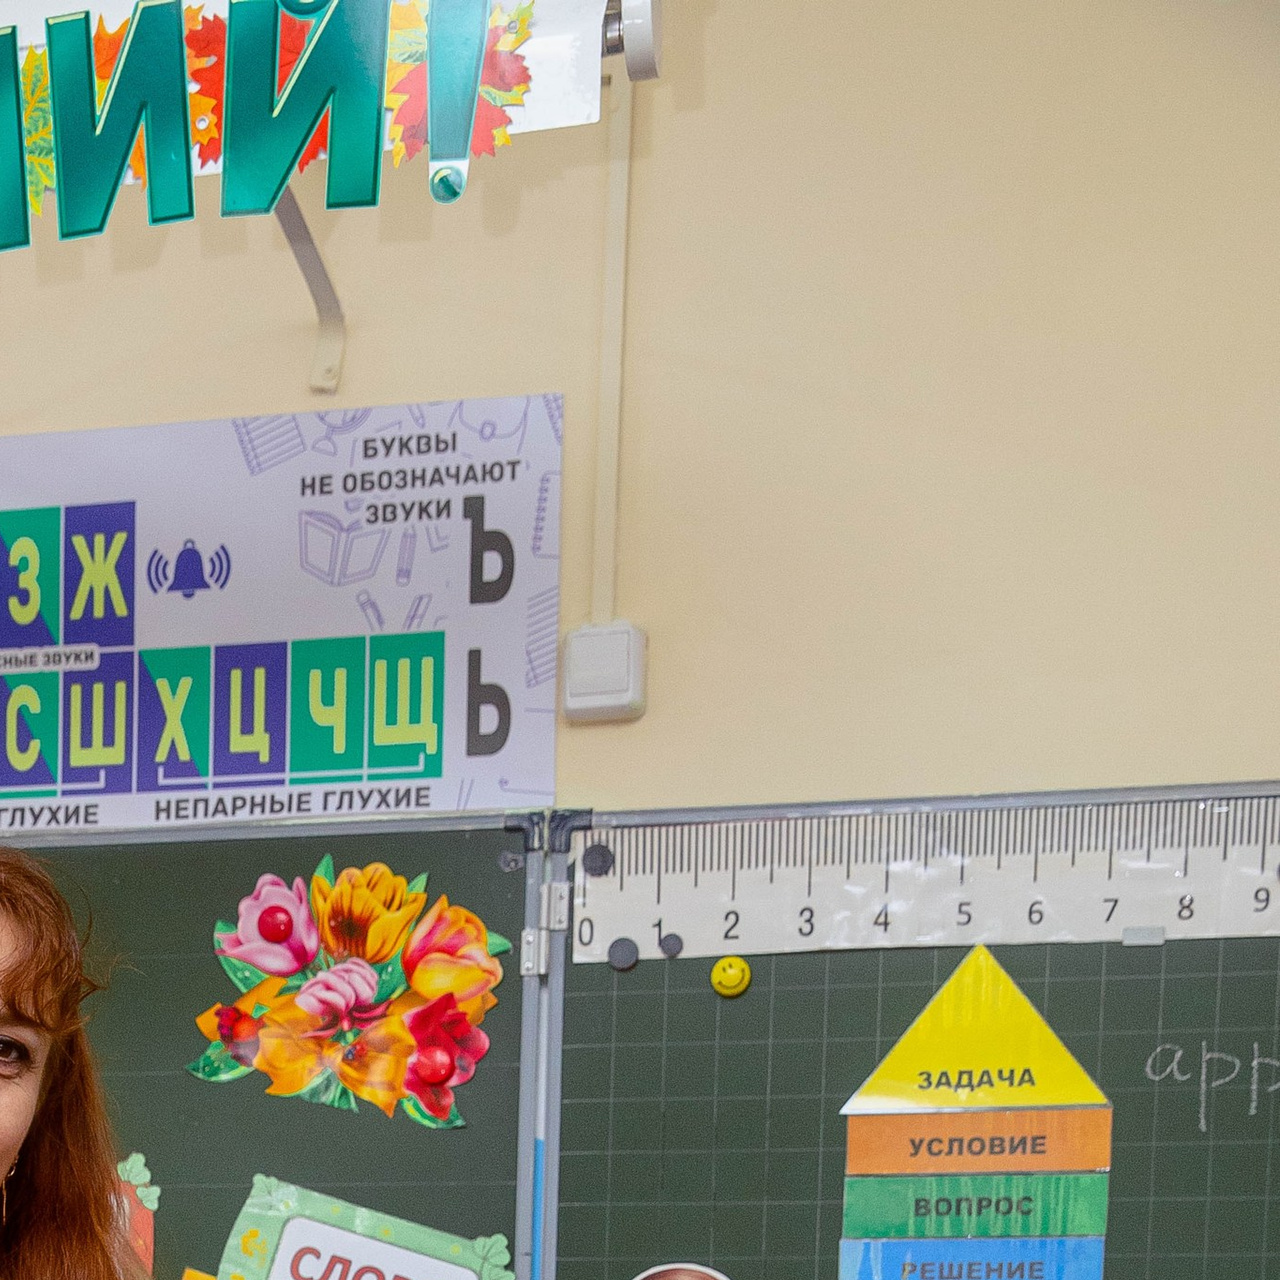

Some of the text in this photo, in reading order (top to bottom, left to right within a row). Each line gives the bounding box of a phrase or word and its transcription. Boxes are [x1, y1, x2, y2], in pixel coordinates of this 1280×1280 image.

[363, 432, 457, 460] БУКВЫ
[300, 461, 521, 497] НЕ ОБОЗНАЧАЮТ
[365, 499, 451, 525] ЗВУКИ
[463, 495, 515, 605] Ъ
[42, 650, 95, 667] ЗВУКИ
[466, 649, 511, 758] Ь
[154, 786, 432, 822] НЕПАРНЫЕ ГЛУХИЕ
[578, 887, 1271, 948] 0 1 2 3 4 5 6 7 8 9
[916, 1066, 1037, 1094] ЗАДАЧА
[907, 1135, 1048, 1159] УСЛОВИЕ
[913, 1194, 1035, 1219] ВОПРОС
